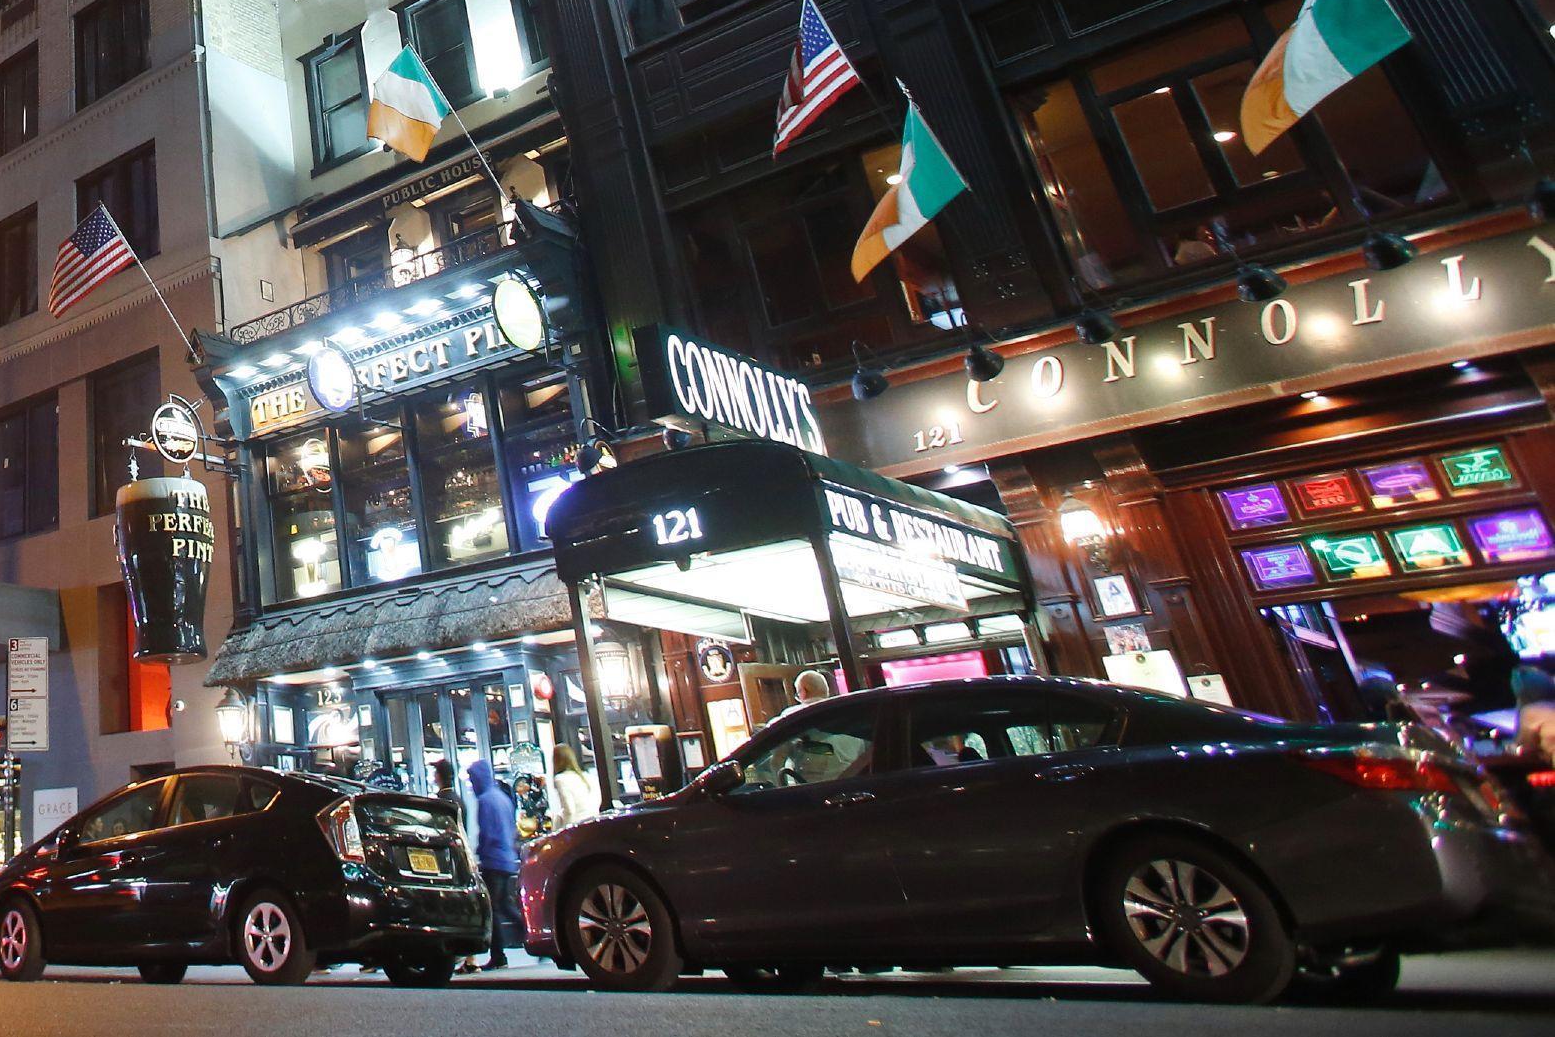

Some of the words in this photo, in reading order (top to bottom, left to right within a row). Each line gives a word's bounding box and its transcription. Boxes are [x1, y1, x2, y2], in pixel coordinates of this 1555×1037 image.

[382, 176, 436, 208] PUBLIC
[251, 386, 308, 424] THE
[667, 334, 828, 457] CONNOLLY'S
[913, 422, 965, 452] 121
[149, 512, 215, 540] PERFE
[652, 507, 703, 545] 121
[824, 489, 869, 535] PUB
[870, 504, 893, 542] &
[889, 509, 1005, 573] RESTAURANT
[172, 537, 215, 563] PINT
[10, 639, 18, 651] 3
[10, 699, 18, 711] 6
[38, 802, 73, 815] GRACE
